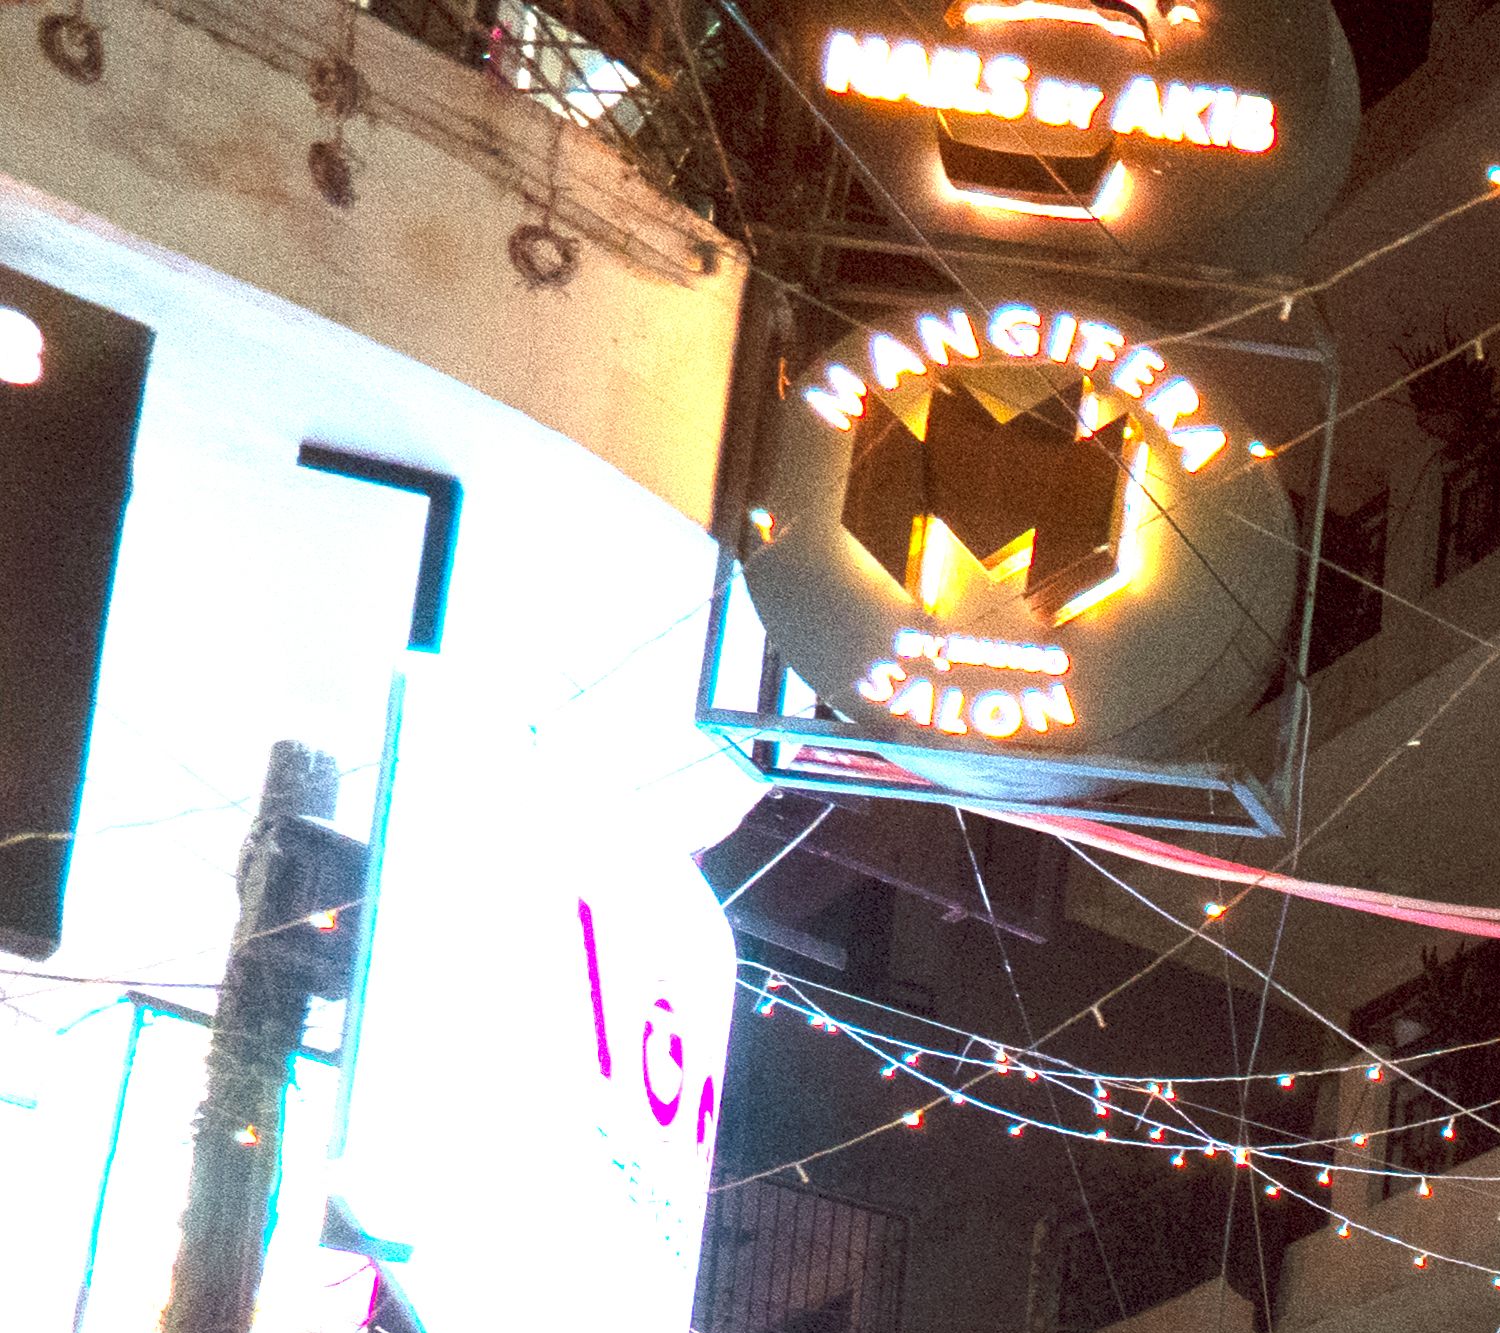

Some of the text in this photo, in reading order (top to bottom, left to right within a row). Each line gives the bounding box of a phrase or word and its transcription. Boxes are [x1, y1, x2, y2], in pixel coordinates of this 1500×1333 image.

[824, 30, 1030, 120] NAILS
[805, 302, 1227, 473] MANGIFERA
[857, 660, 1077, 738] SALON
